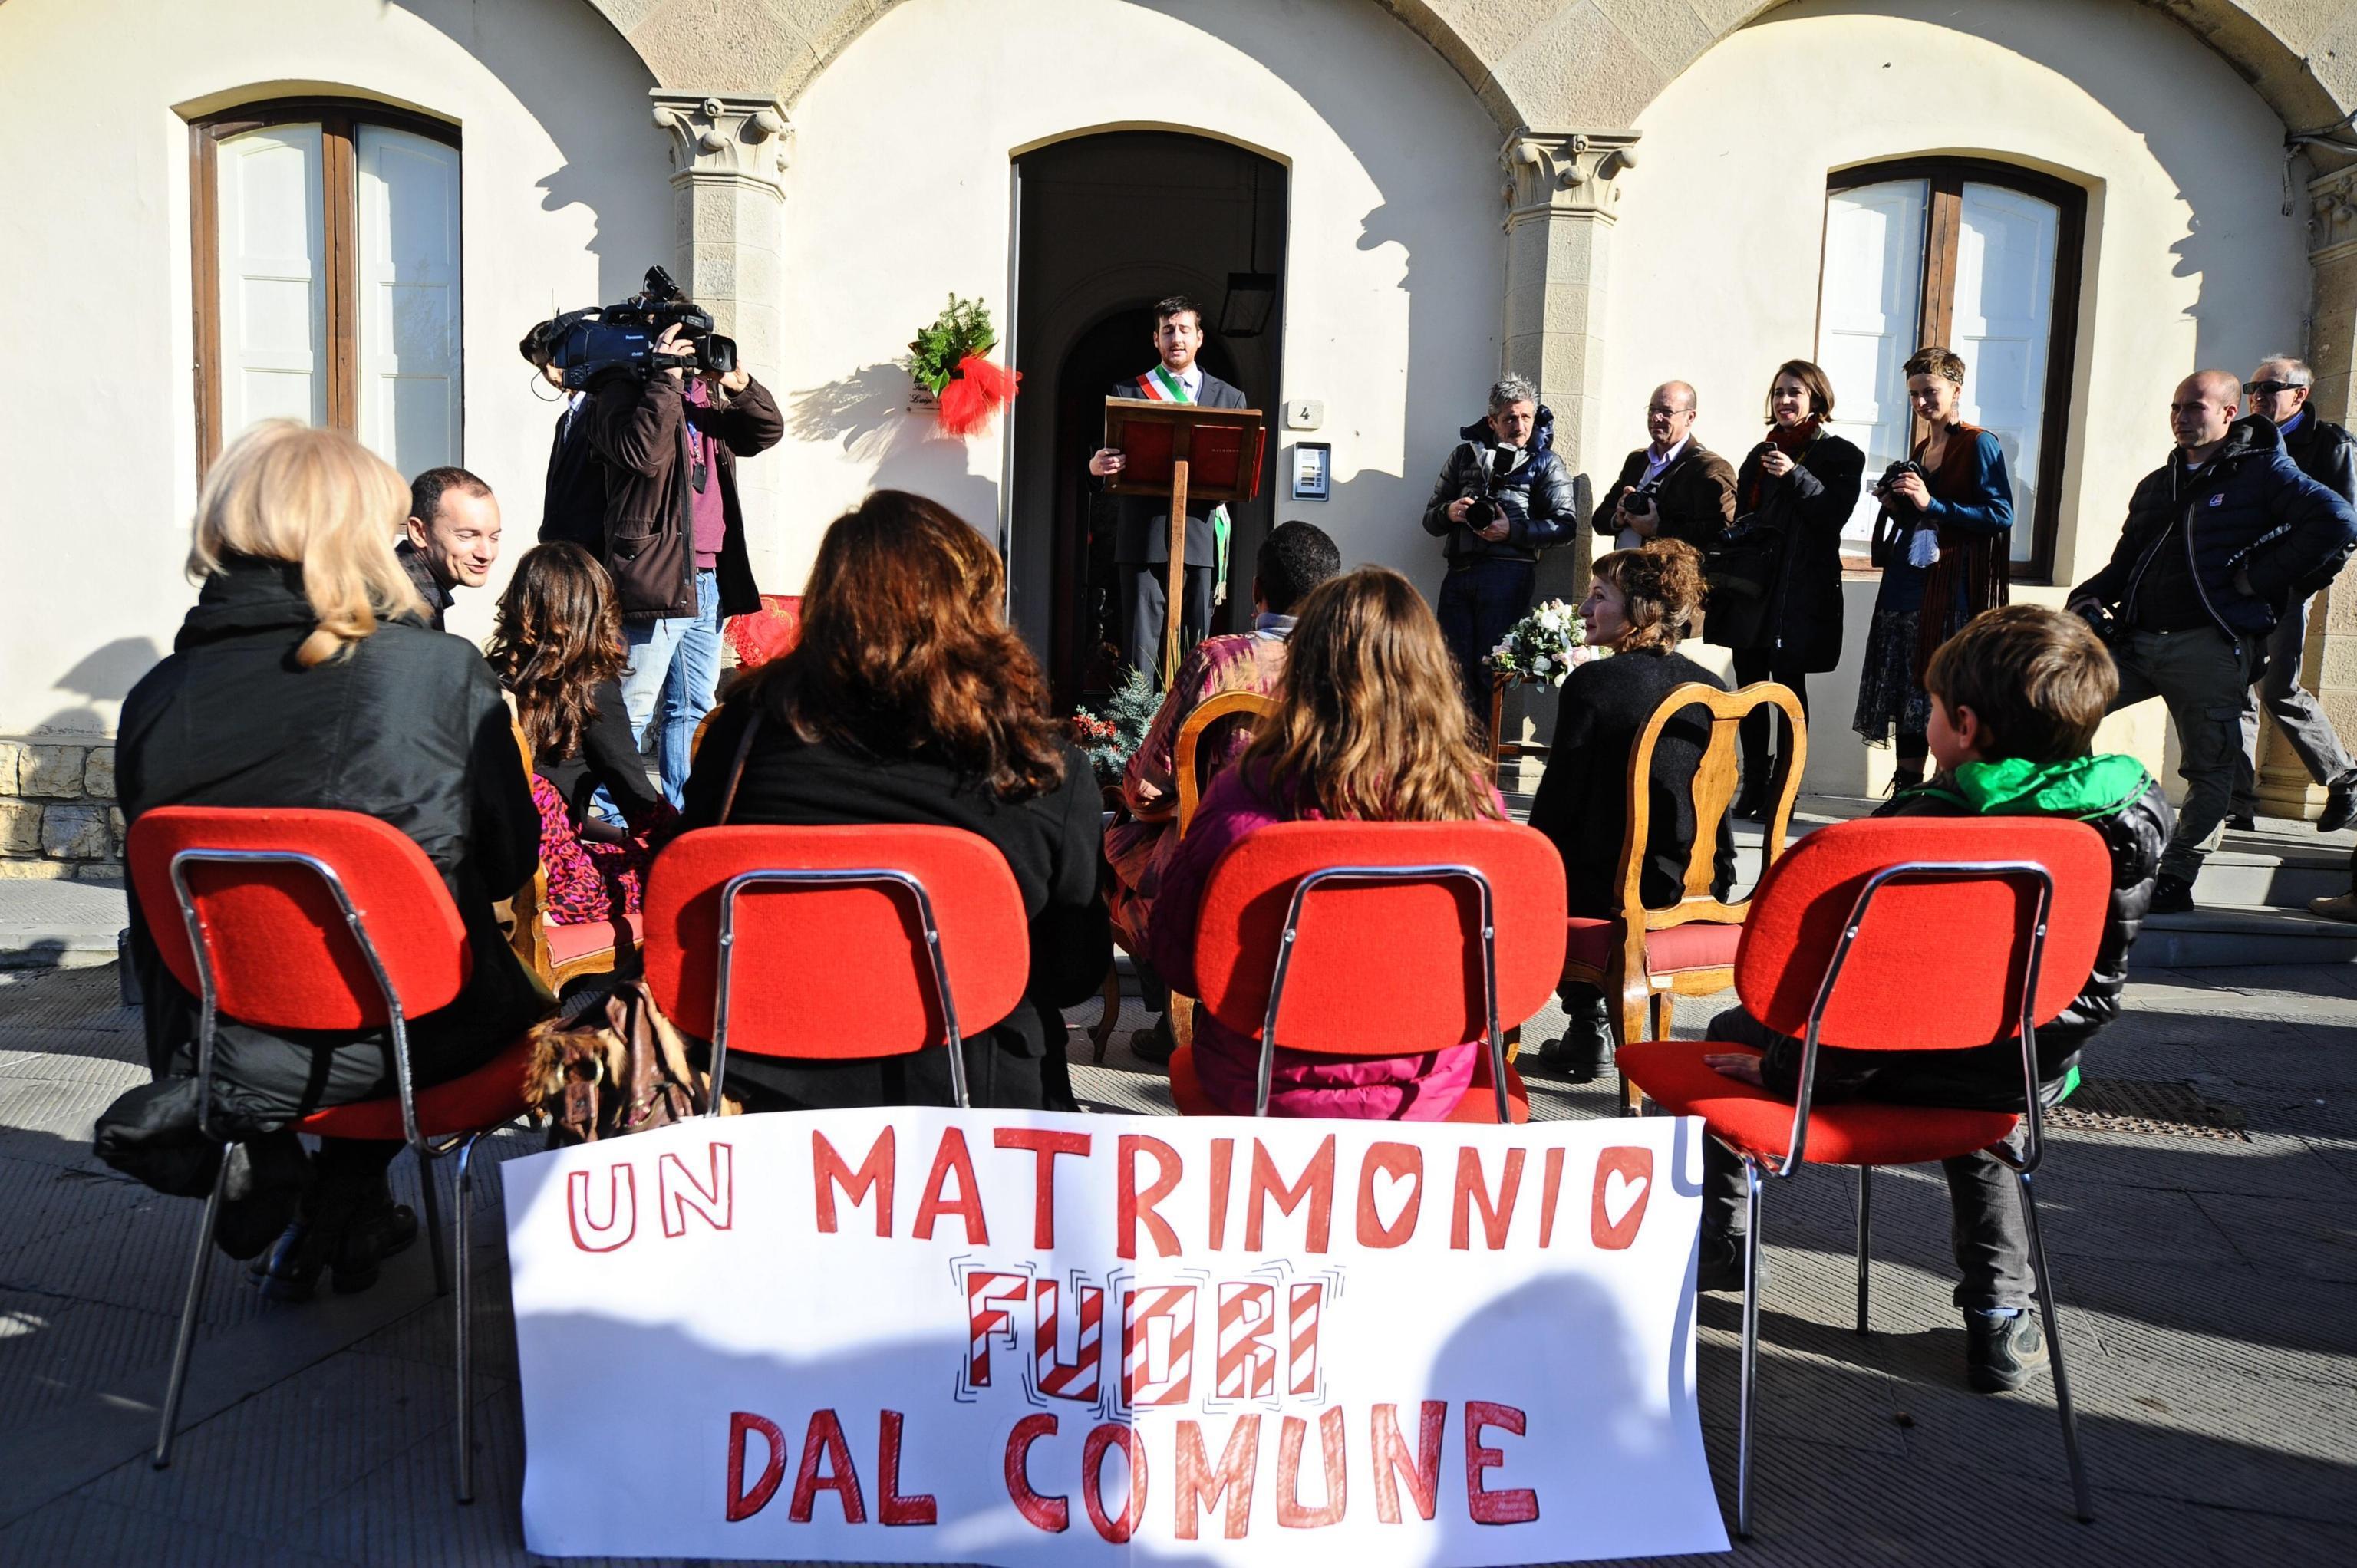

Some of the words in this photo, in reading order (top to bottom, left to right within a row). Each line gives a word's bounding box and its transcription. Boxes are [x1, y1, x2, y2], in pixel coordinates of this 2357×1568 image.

[1299, 407, 1310, 420] 4
[567, 1141, 733, 1253] UN
[811, 1124, 1653, 1260] MATRIMONIO
[968, 1271, 1324, 1406] FUORI
[727, 1408, 938, 1527] DAL
[1004, 1400, 1540, 1545] COMUNE
